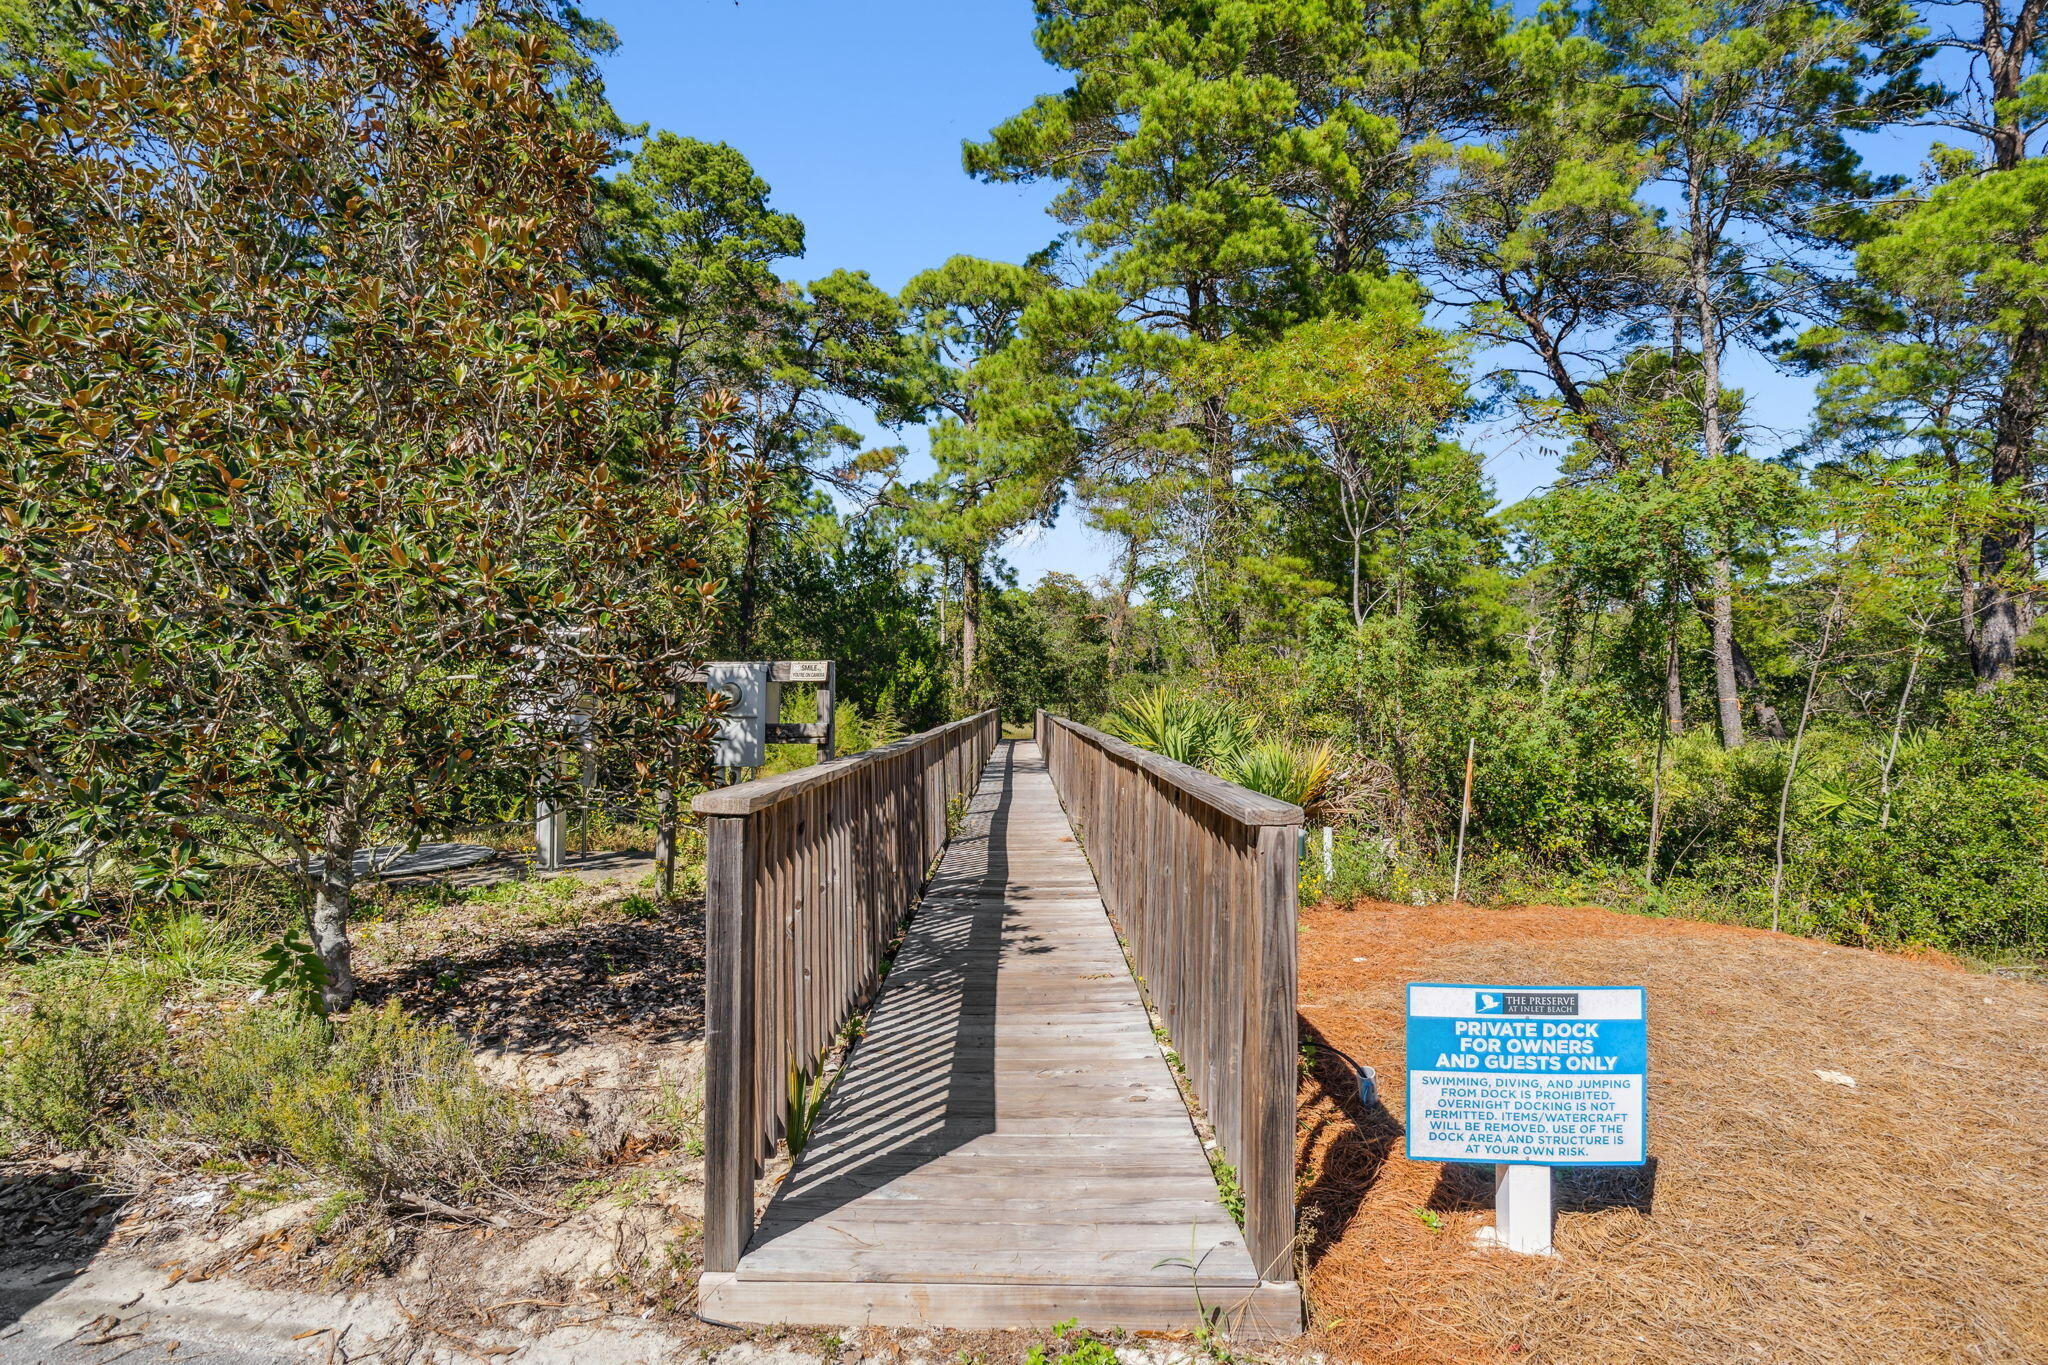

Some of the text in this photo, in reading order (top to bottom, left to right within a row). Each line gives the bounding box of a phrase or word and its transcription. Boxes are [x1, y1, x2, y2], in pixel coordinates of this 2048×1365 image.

[1506, 996, 1575, 1005] THE PRESERVE
[1455, 1022, 1598, 1037] PRIVATE DOCK
[1460, 1039, 1594, 1054] FOR OWNERS
[1436, 1054, 1617, 1070] AND GUESTS ONLY
[1422, 1076, 1630, 1088] SWIMMING, DIVING, AND JUMPING
[1441, 1088, 1612, 1100] FROM DOCK IS PROHIBITED.
[1438, 1100, 1616, 1111] OVERNIGHT DOCKING IS NOT
[1425, 1110, 1627, 1123] PERMITTED. ITEMS/WATERCRAFT
[1430, 1122, 1623, 1134] WILL BE REMOVED. USE OF THE
[1429, 1132, 1623, 1144] DOCK AREA AND STRUCTURE IS
[1465, 1145, 1588, 1156] AT YOUR OWN RISK.
